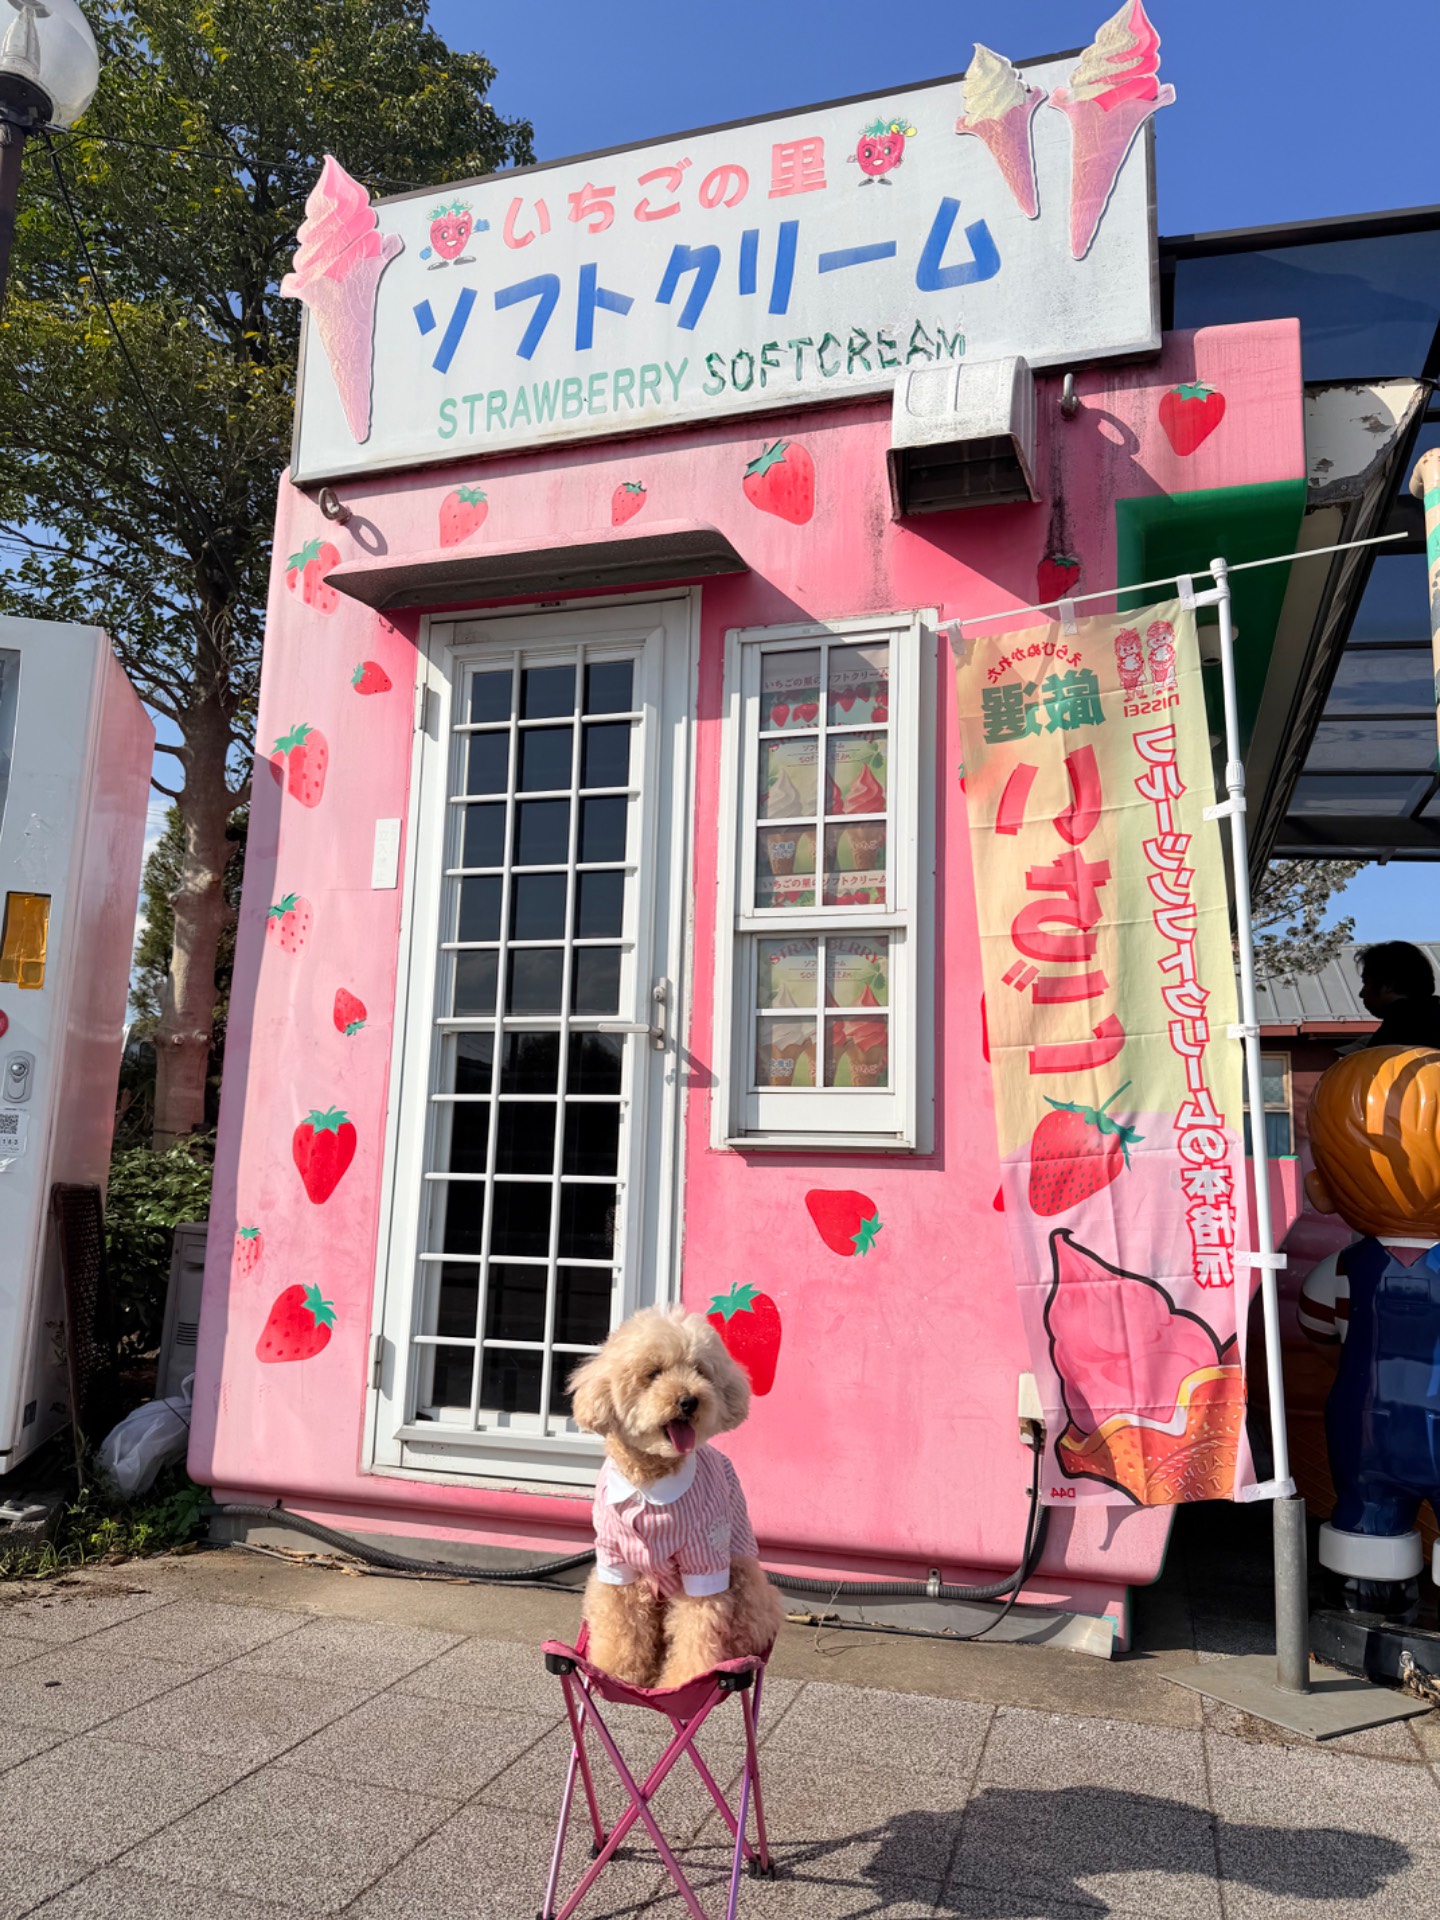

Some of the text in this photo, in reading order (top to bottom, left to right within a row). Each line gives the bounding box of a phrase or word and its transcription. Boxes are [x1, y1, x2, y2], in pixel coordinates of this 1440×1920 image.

[503, 136, 827, 249] いちごの里
[412, 196, 1001, 375] ソフトクリーム
[437, 357, 689, 440] STRAWBERRY
